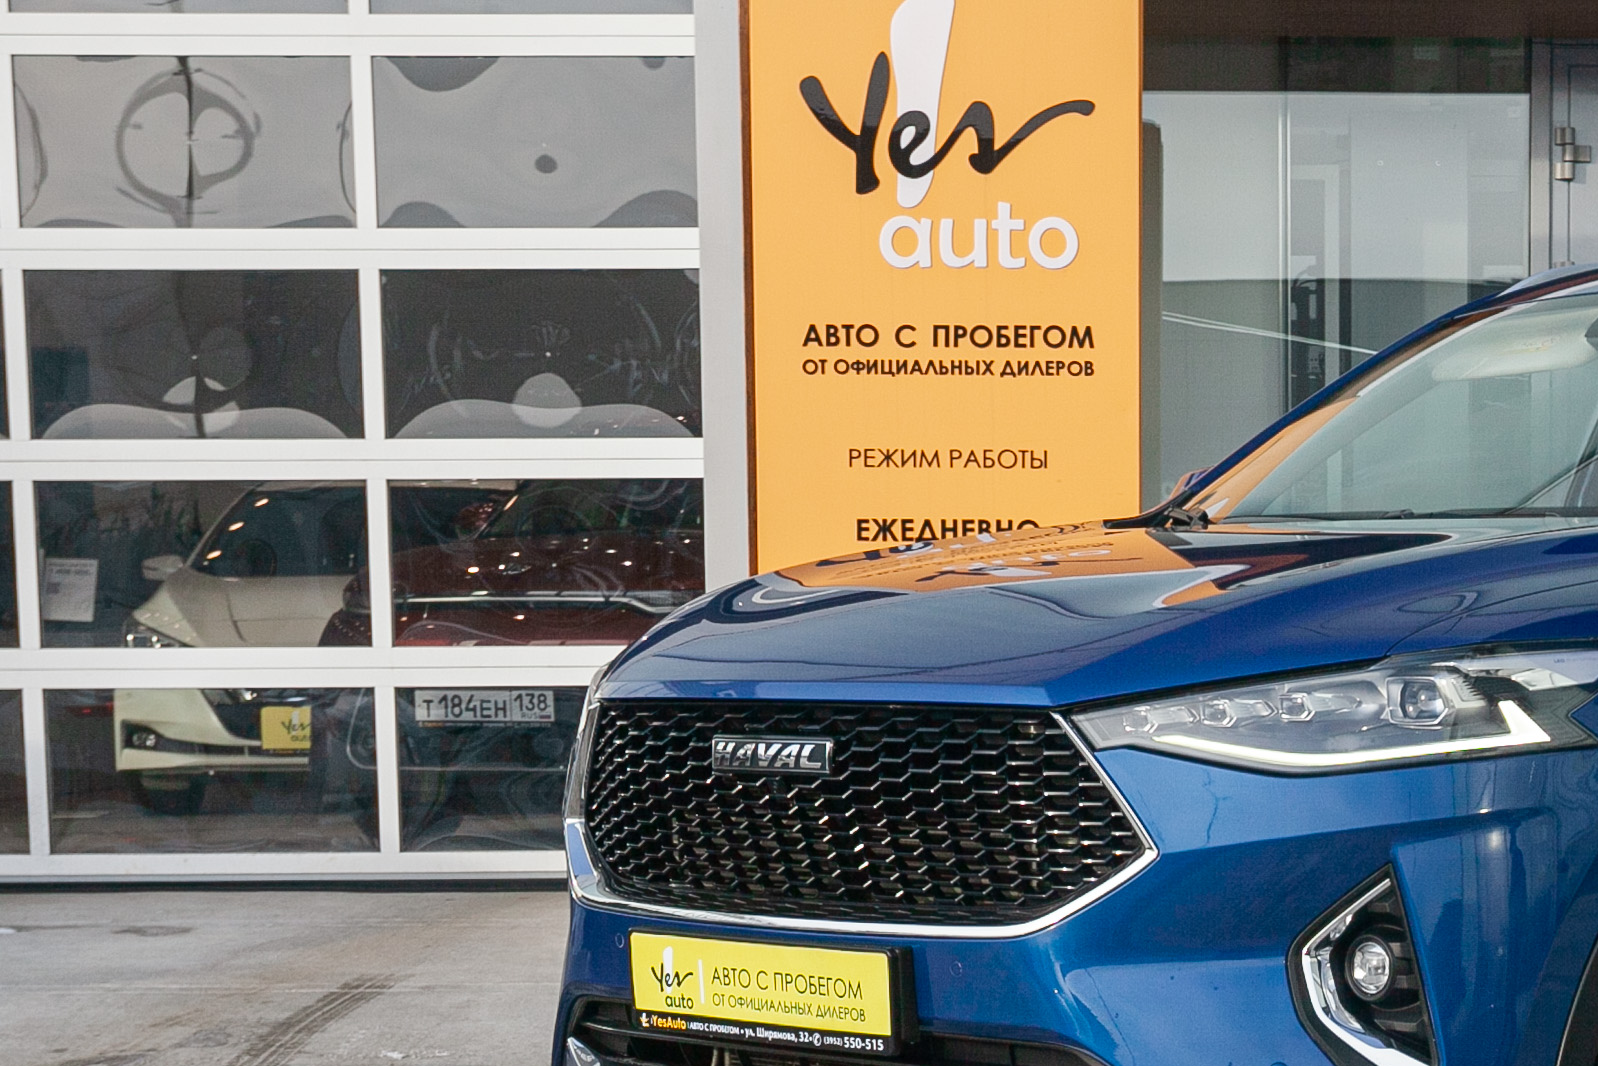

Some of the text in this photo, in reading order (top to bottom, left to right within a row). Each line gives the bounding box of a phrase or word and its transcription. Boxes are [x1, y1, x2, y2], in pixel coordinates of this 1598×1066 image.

[799, 50, 1095, 194] Yes
[879, 201, 1079, 270] auto
[802, 323, 1095, 349] АВТО С ПРОБЕГОМ
[802, 358, 1095, 378] ОТ ОФИЦИАЛЬНЫХ ДИЛЕРОВ
[848, 448, 1048, 469] РЕЖИМ РАБОТЫ
[513, 692, 548, 712] 138
[715, 741, 822, 768] HAVAL
[650, 962, 694, 993] Yes
[711, 966, 864, 1000] АВТО С ПРОБЕГОМ
[665, 993, 694, 1010] auto
[712, 993, 866, 1022] ОТ ОФИЦИАЛЬНЫХ ДИЛЕРОВ
[844, 1036, 884, 1051] 550-515
